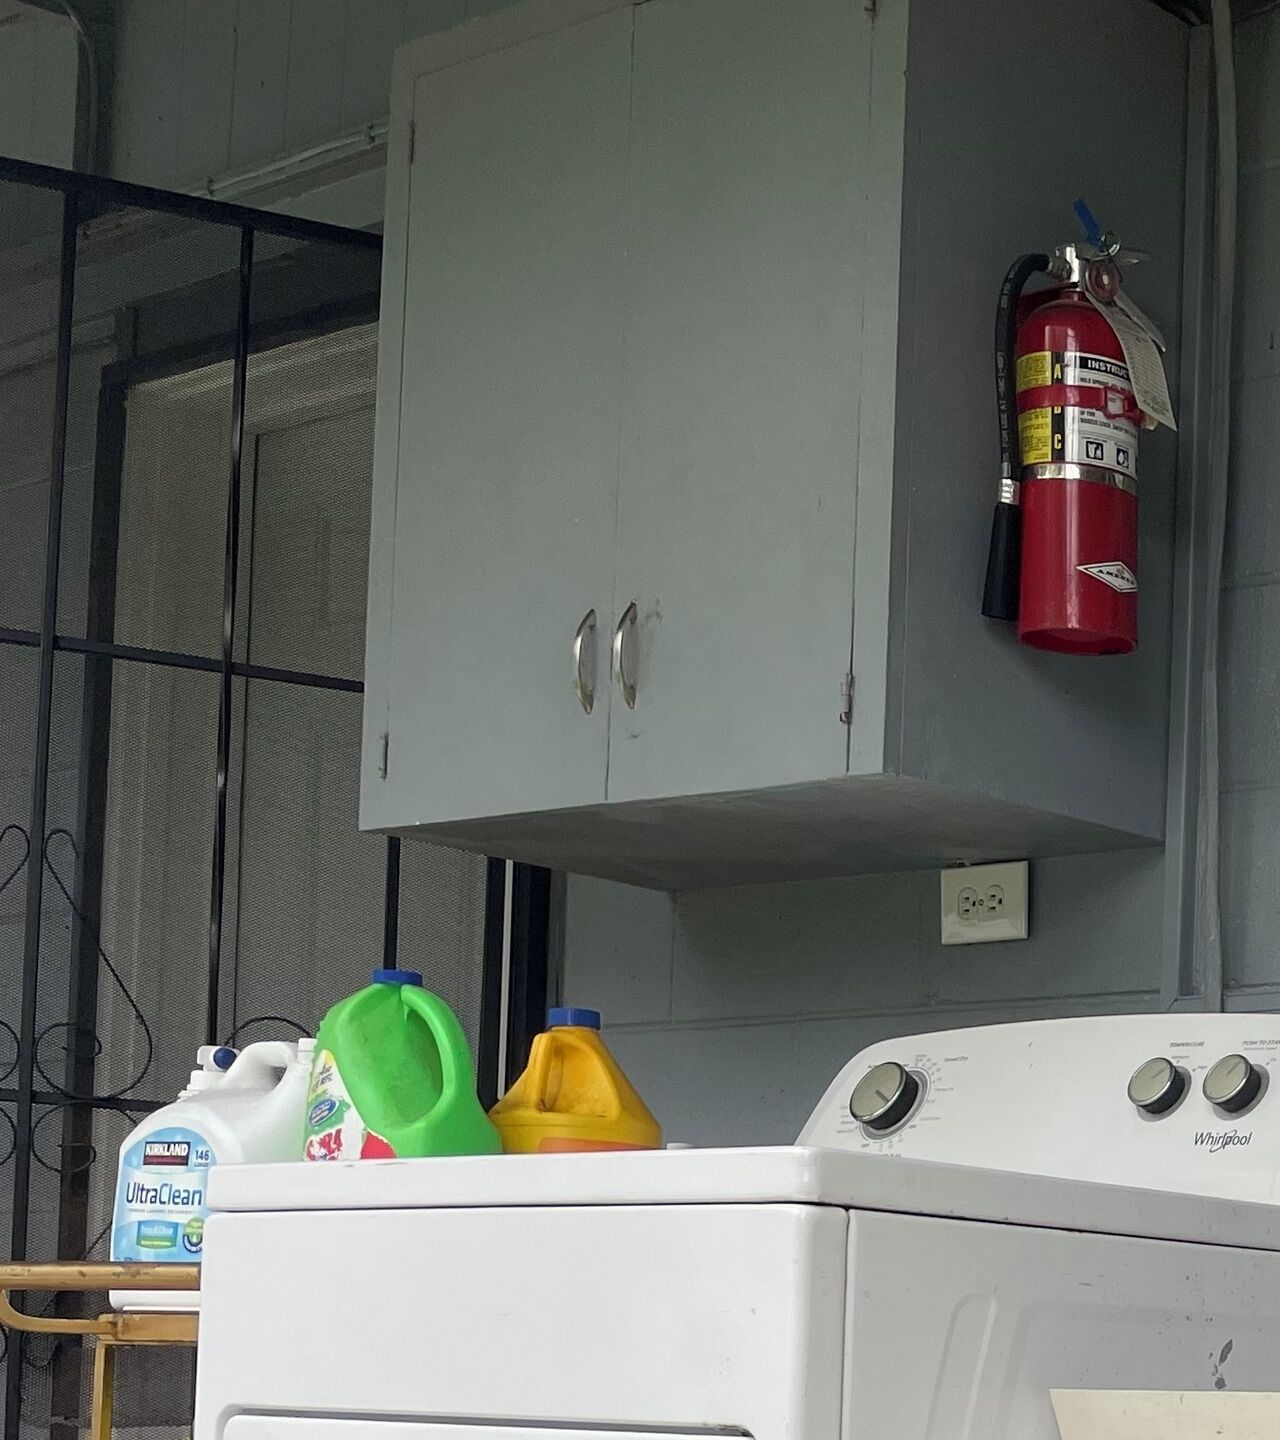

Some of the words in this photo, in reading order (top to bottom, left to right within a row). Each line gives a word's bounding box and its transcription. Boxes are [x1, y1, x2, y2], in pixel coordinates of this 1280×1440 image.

[1054, 364, 1061, 379] A
[1054, 434, 1061, 449] C
[1194, 1130, 1252, 1153] Whirlpool
[145, 1143, 189, 1156] KIRKLAND
[195, 1150, 209, 1161] 146
[126, 1182, 203, 1206] UltraClean
